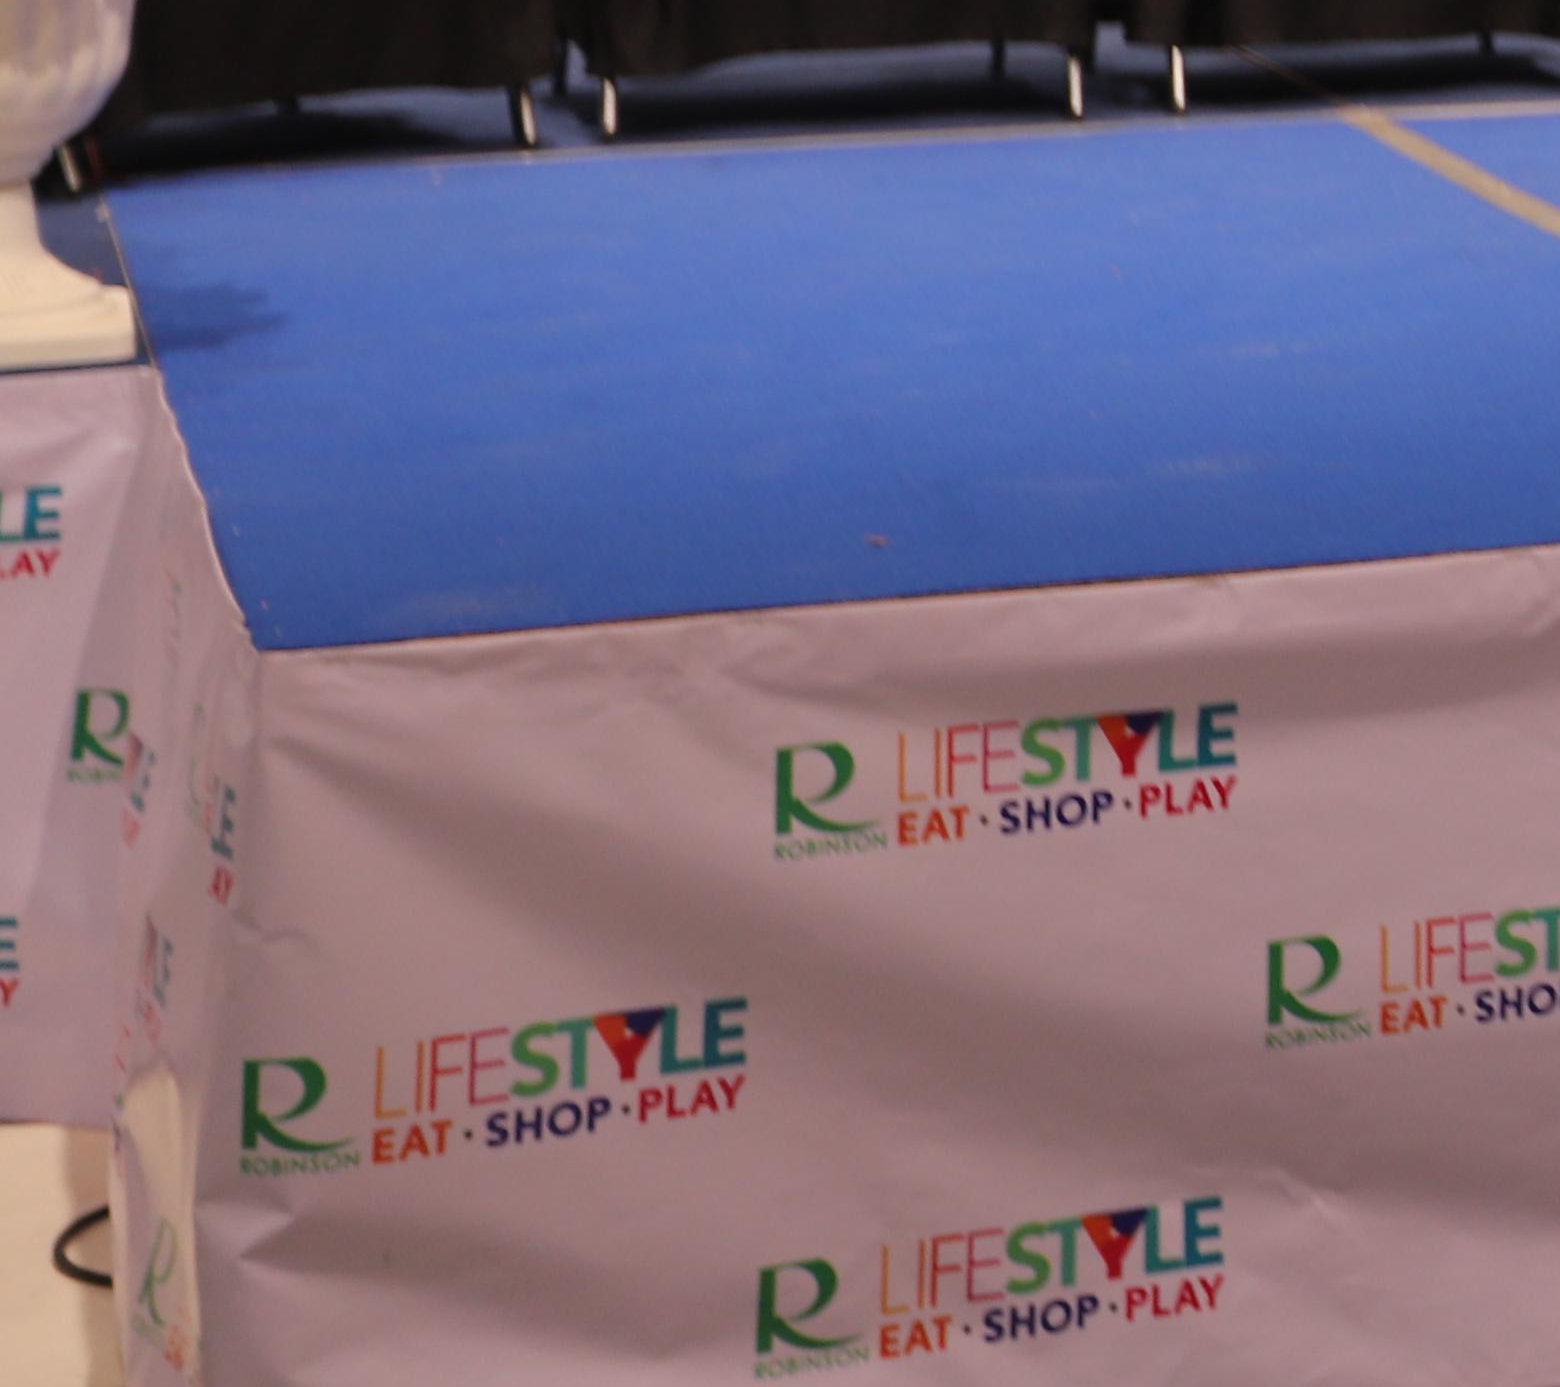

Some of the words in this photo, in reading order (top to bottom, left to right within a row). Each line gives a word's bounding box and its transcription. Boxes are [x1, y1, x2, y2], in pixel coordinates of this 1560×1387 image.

[775, 740, 882, 836] R
[898, 701, 1239, 803] LIFESTYLE
[897, 805, 971, 847] EAT
[1001, 790, 1115, 835] SHOP
[1138, 775, 1238, 820] PLAY
[773, 829, 889, 862] ROBINSON
[1267, 934, 1365, 1026] R
[1380, 996, 1449, 1037] EAT
[241, 1055, 356, 1151] R
[372, 996, 748, 1120] LIFESTYLE
[239, 1148, 362, 1177] ROBINSON
[371, 1119, 452, 1166] EAT
[485, 1095, 612, 1149] SHOP
[636, 1073, 746, 1124] PLAY
[756, 1257, 863, 1355] R
[879, 1195, 1225, 1316] LIFESTYLE
[879, 1314, 955, 1361] EAT
[982, 1293, 1100, 1344] SHOP
[1124, 1273, 1225, 1322] PLAY
